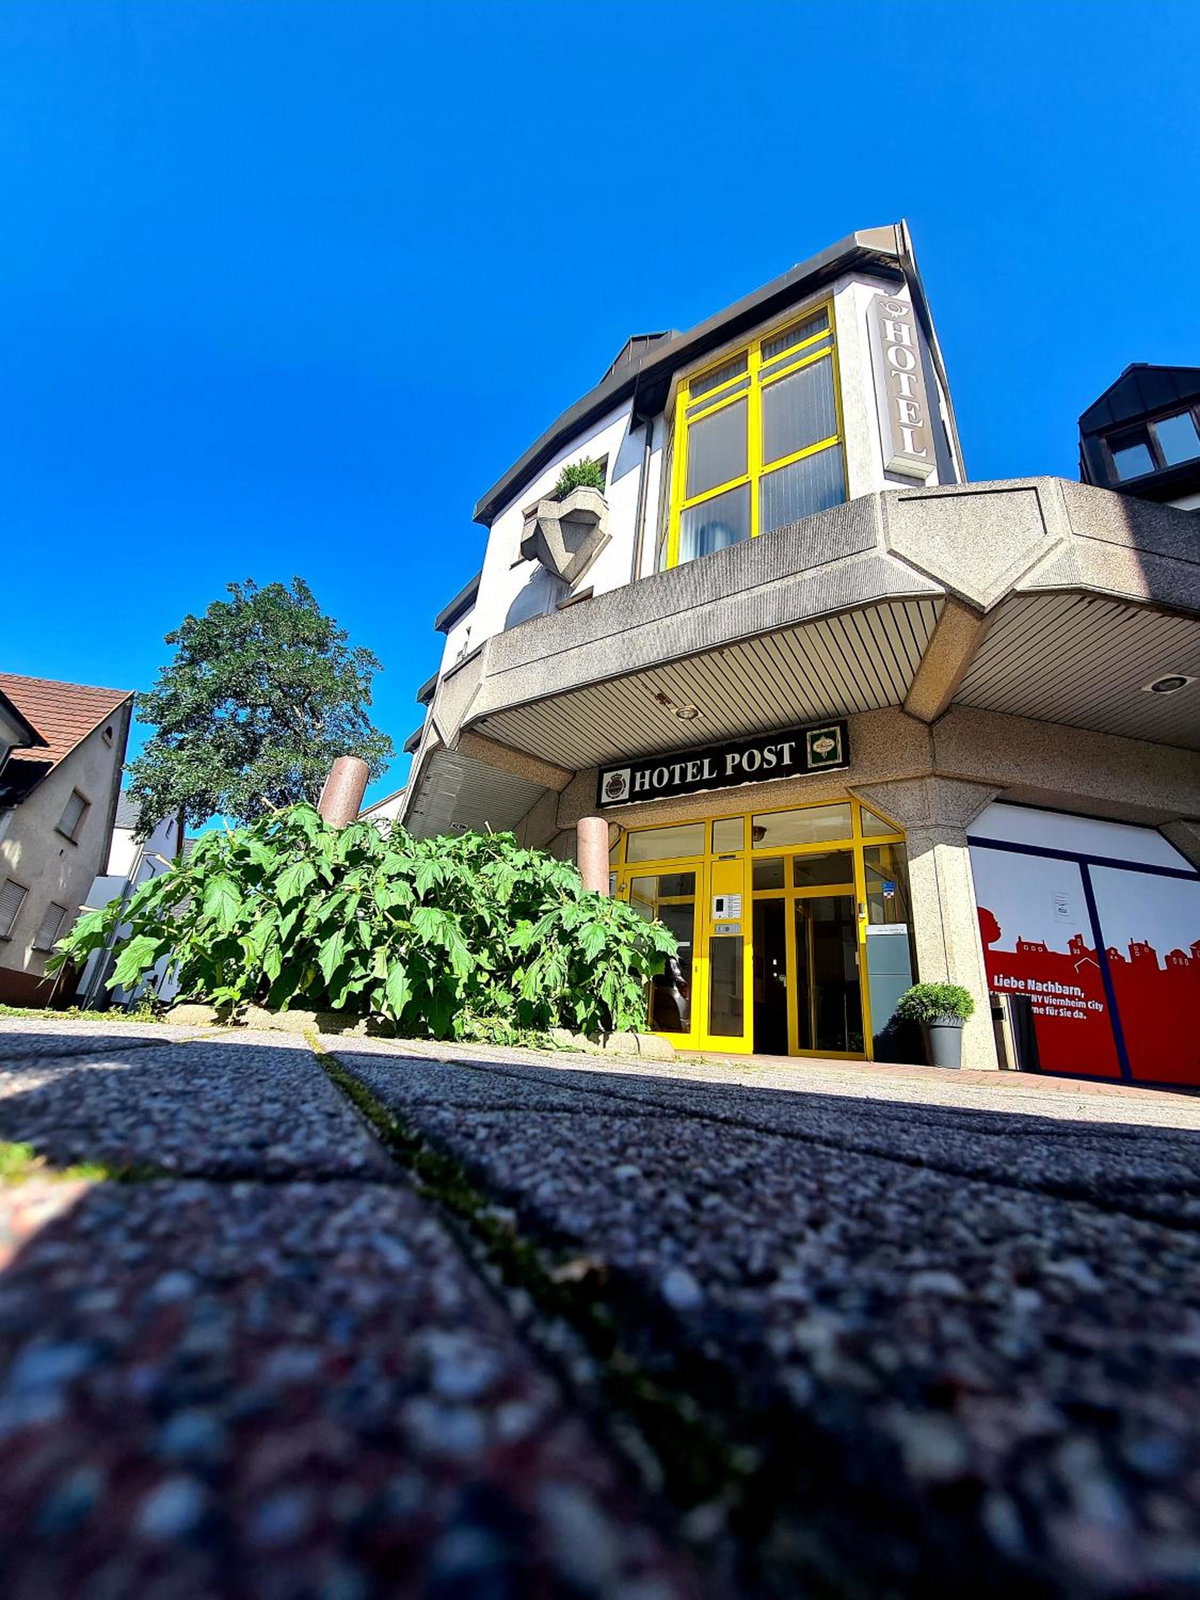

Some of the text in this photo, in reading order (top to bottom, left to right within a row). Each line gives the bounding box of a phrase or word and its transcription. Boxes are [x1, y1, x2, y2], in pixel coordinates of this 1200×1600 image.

[881, 318, 927, 458] HOTEL
[633, 757, 717, 793] HOTEL
[725, 741, 796, 775] POST
[993, 974, 1025, 989] Liebe
[1027, 979, 1085, 998] Nachbarn,
[1044, 995, 1086, 1009] Viernheim
[1087, 1000, 1104, 1012] City
[1046, 1006, 1058, 1016] für
[1059, 1008, 1071, 1018] Sie
[1073, 1010, 1087, 1019] da.
